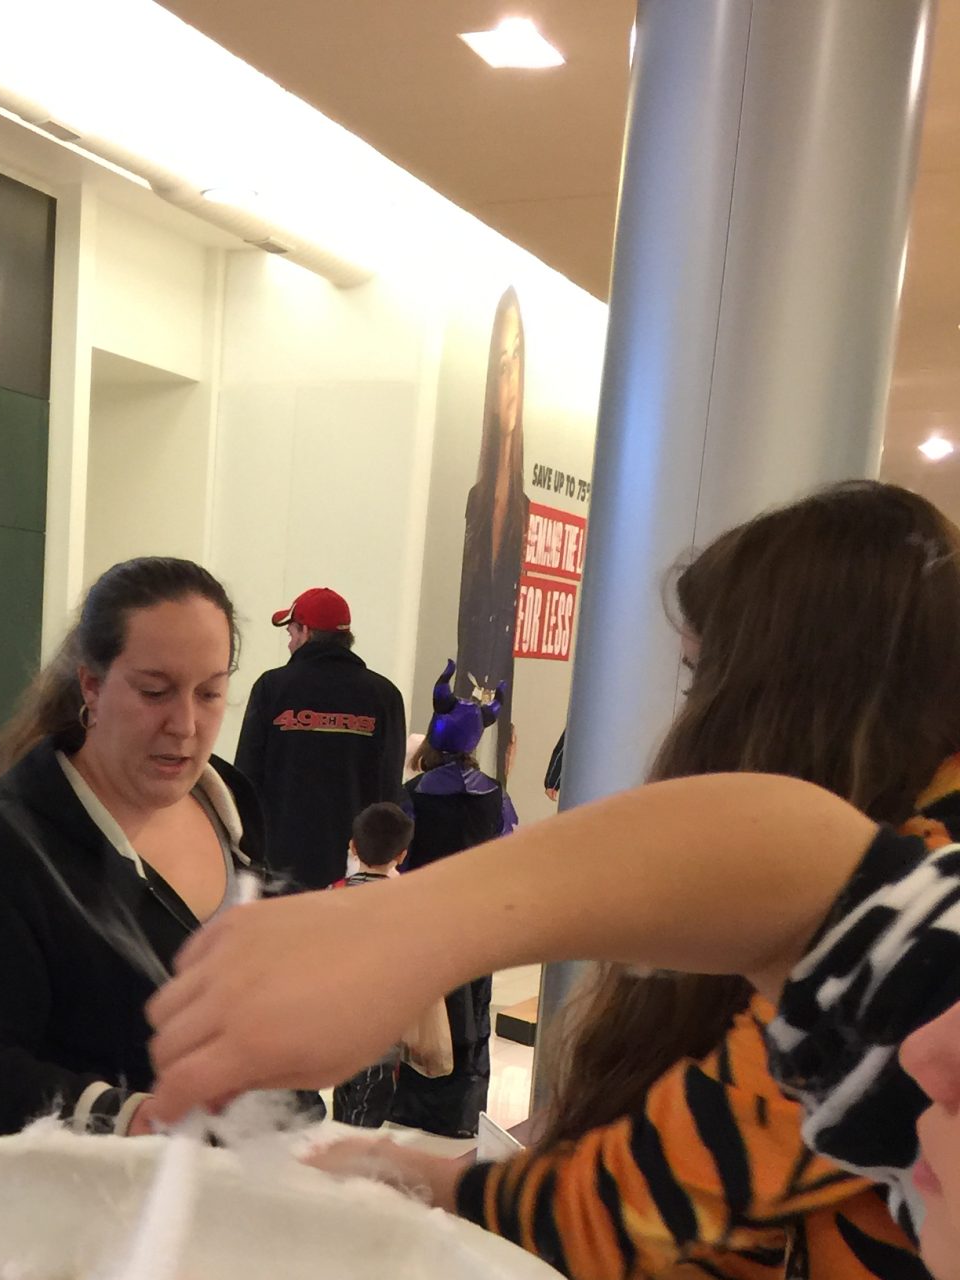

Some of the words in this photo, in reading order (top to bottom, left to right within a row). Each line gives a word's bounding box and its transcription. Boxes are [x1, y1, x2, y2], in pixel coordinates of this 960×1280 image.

[532, 463, 553, 490] SAVE
[554, 470, 565, 494] UP
[565, 474, 576, 498] TO
[514, 586, 542, 653] FOR
[541, 591, 573, 656] LESS
